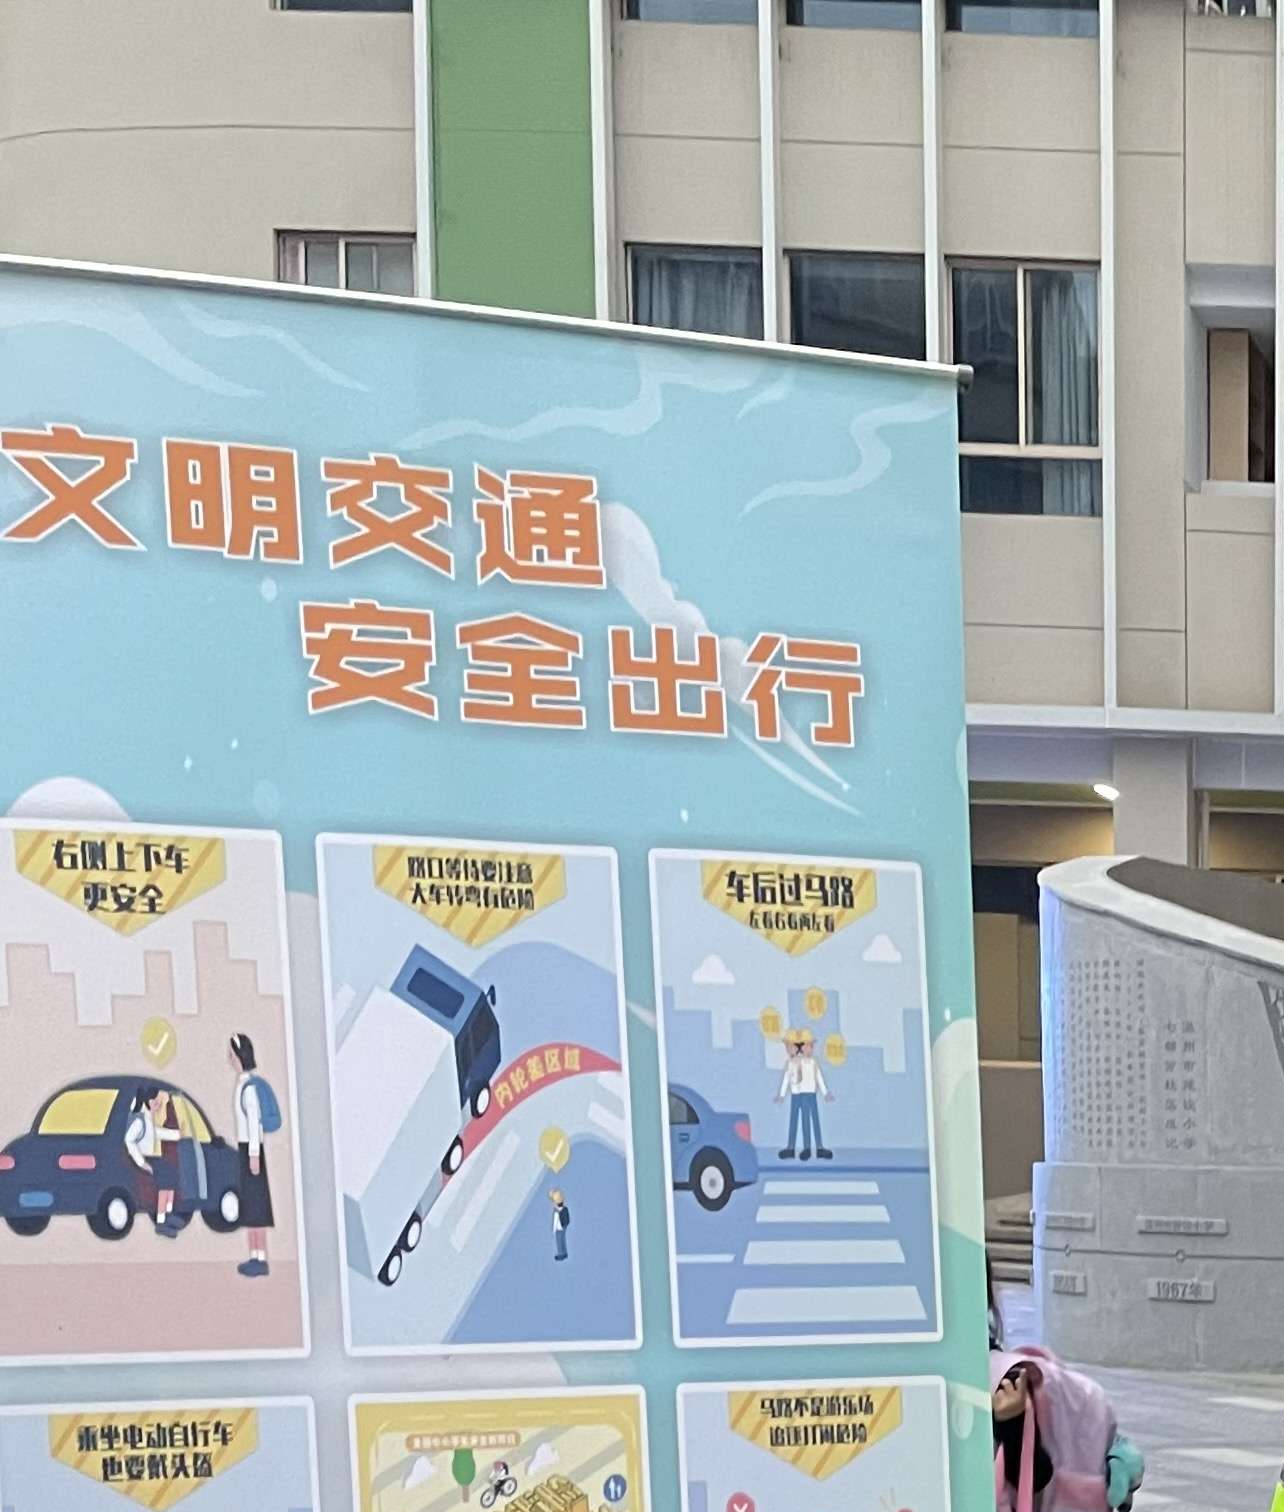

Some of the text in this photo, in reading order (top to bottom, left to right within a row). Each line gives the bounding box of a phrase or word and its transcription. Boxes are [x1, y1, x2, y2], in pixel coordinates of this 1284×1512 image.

[1, 422, 606, 588] 文明交通
[299, 598, 865, 747] 安全出行
[52, 839, 189, 874] 右侧上下车
[82, 881, 166, 913] 更安全
[725, 870, 854, 908] 车后过马路
[77, 1421, 234, 1451] 乘坐电动自行车
